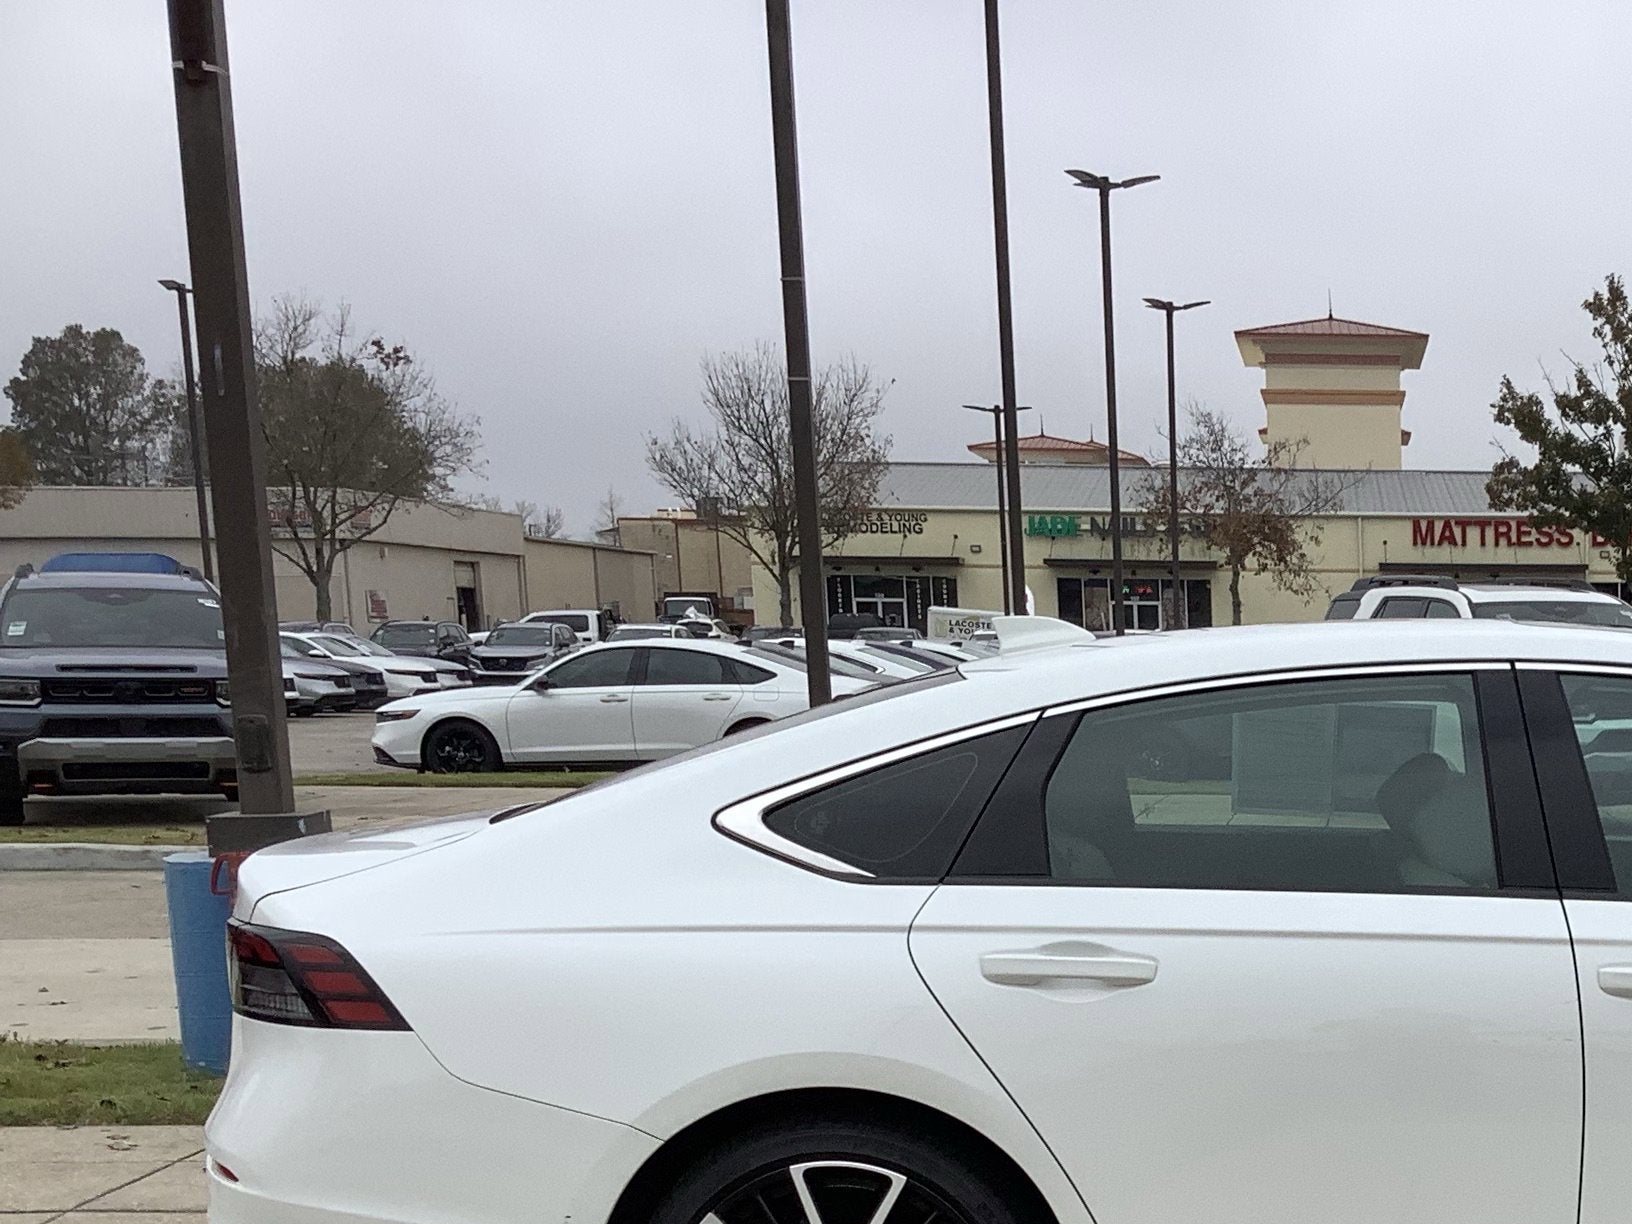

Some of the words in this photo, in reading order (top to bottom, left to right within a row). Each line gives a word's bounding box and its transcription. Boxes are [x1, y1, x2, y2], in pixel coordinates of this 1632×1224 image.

[887, 512, 928, 523] YOUNG
[833, 522, 923, 535] MODELING
[1411, 518, 1575, 548] MATTRESS
[948, 619, 992, 630] LACOSTE
